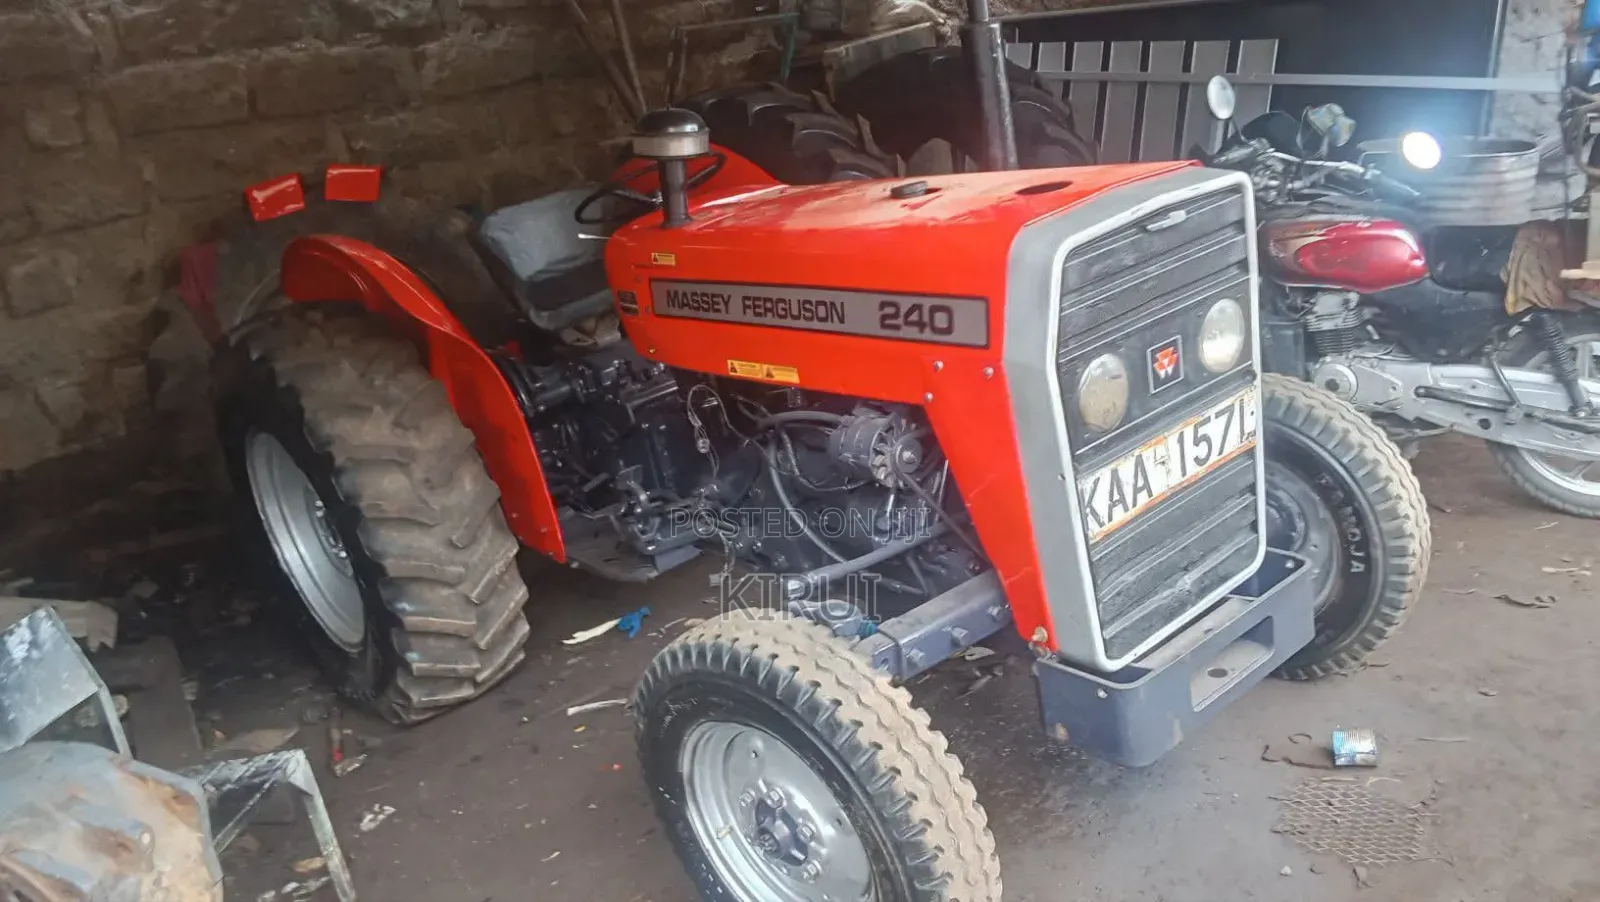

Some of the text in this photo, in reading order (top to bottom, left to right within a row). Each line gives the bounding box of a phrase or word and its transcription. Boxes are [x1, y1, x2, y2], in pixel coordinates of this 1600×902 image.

[666, 290, 731, 315] MASSEY
[742, 295, 845, 325] FERGUSON
[878, 300, 954, 336] 240
[1082, 454, 1153, 530] KAA
